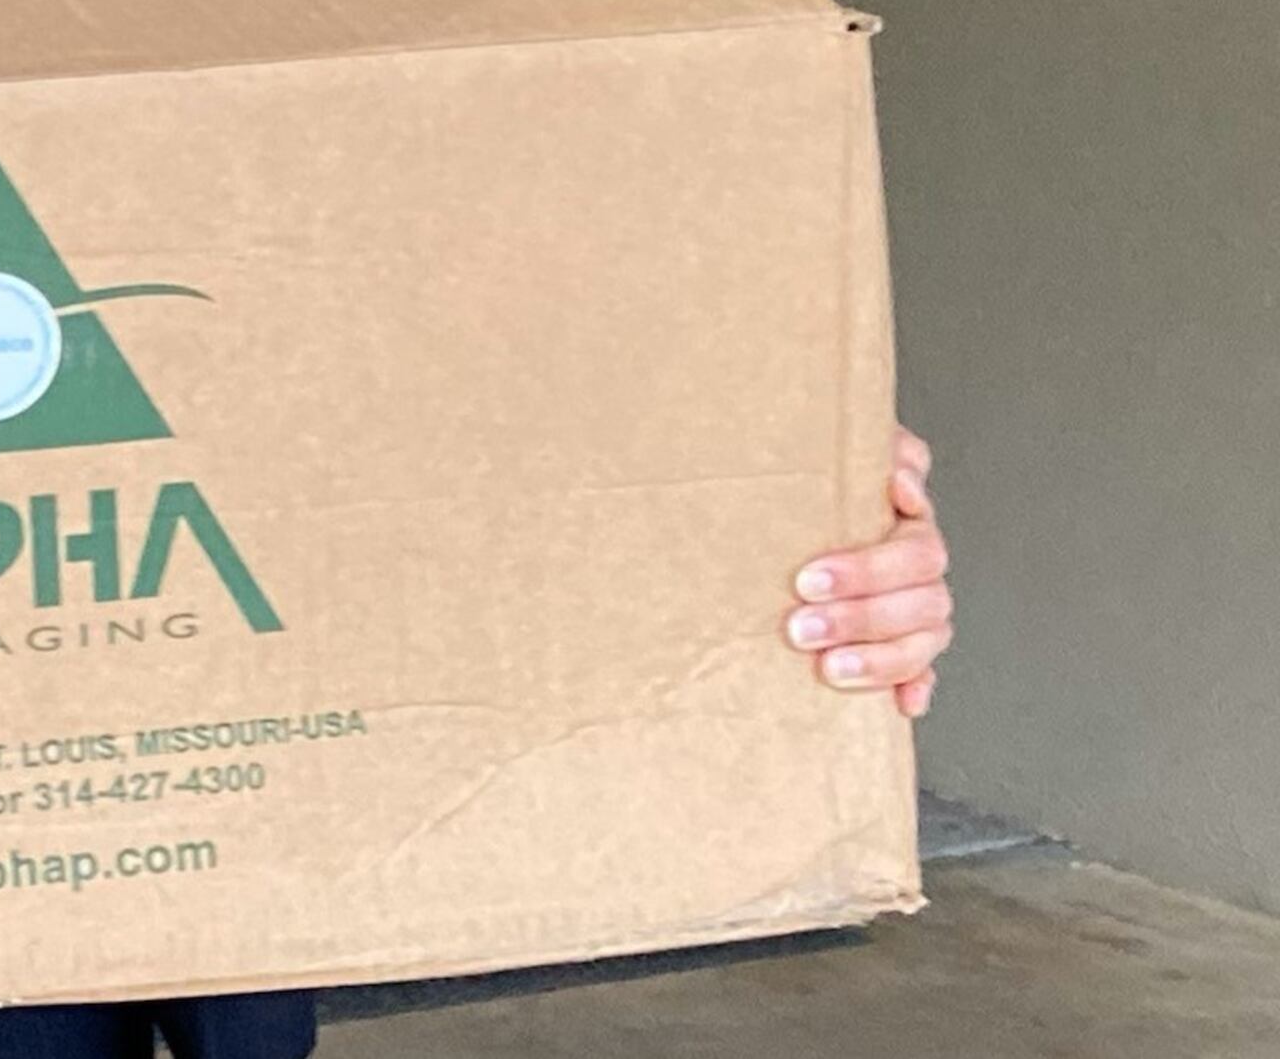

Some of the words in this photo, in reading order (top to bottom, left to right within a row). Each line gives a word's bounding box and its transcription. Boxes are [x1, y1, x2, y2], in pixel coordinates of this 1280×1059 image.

[22, 733, 128, 769] LOUIS,
[136, 709, 369, 757] MISSOURI-USA
[34, 762, 266, 811] 314-427-4300
